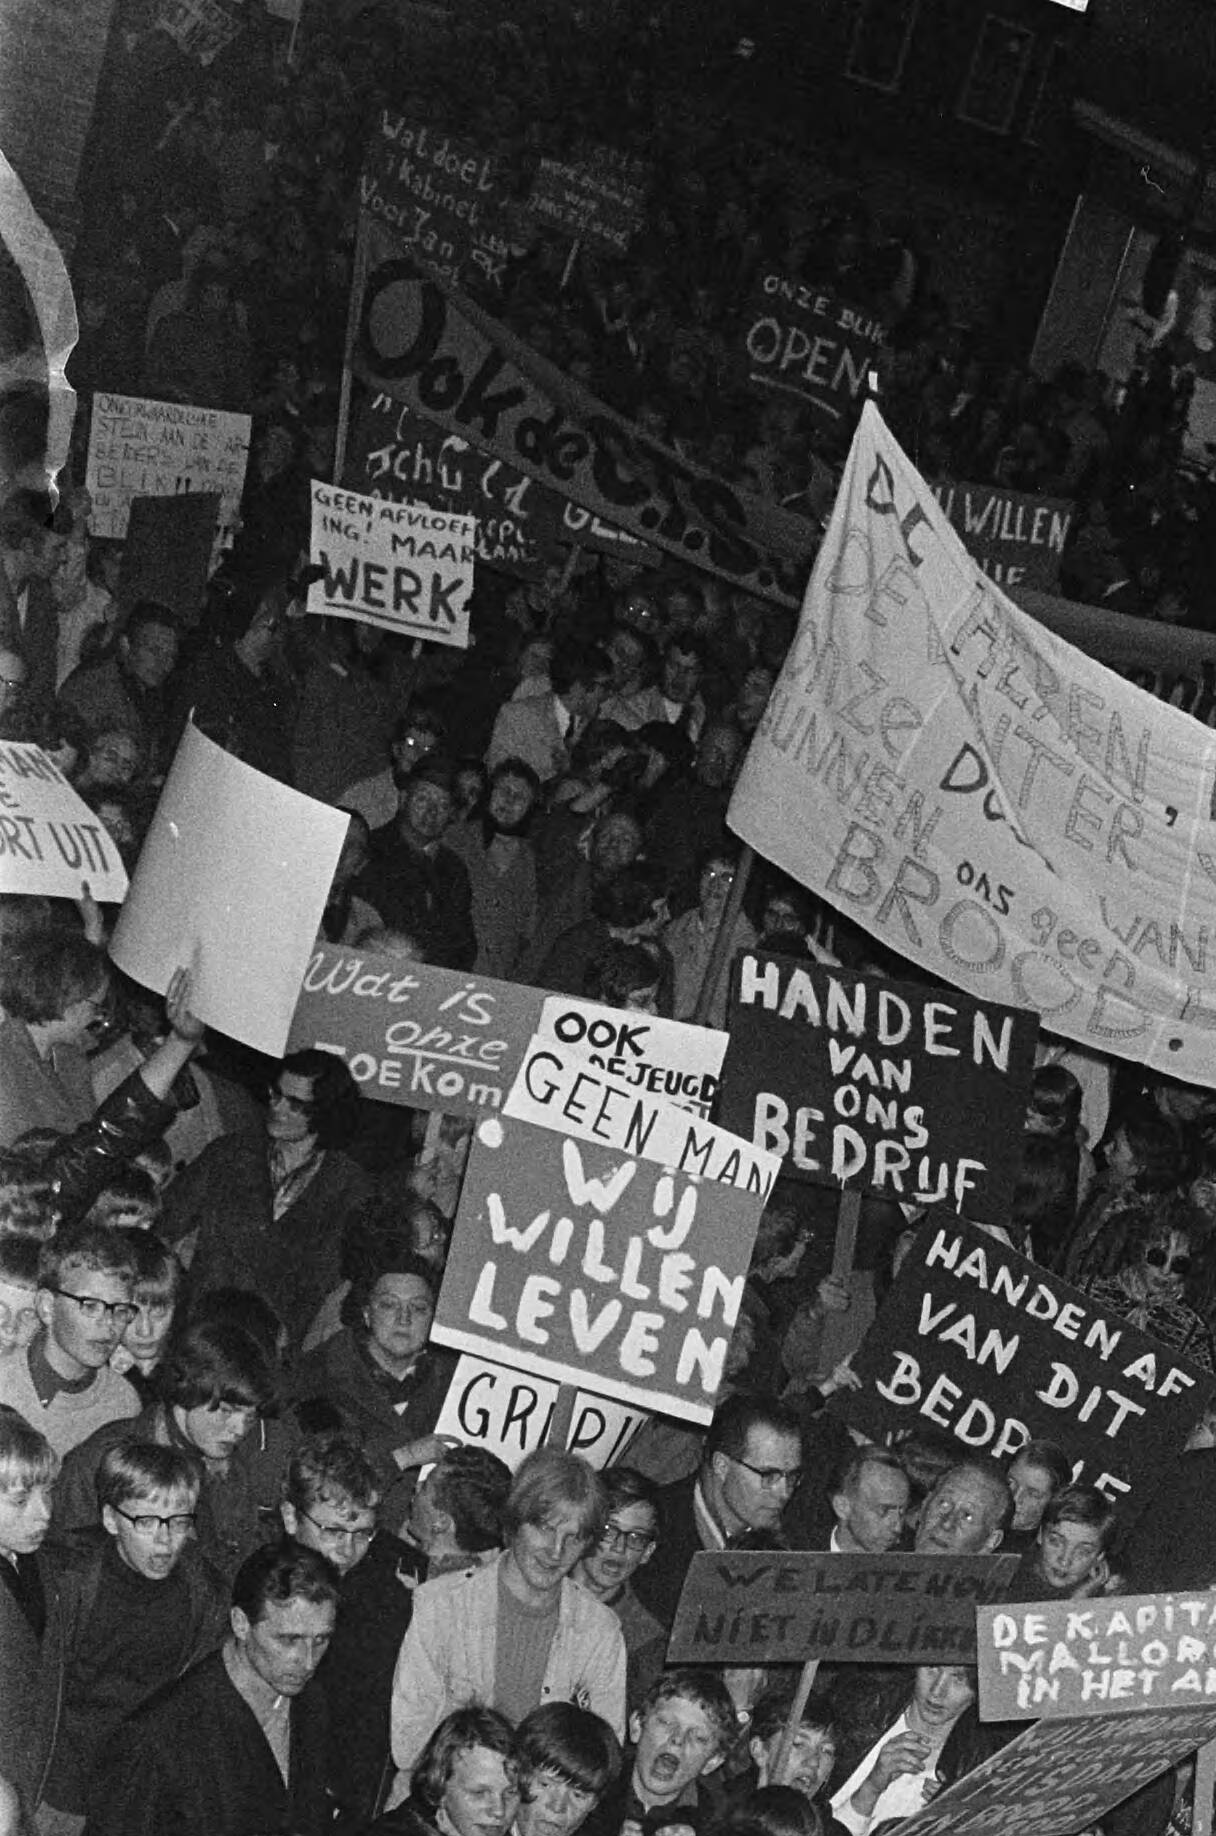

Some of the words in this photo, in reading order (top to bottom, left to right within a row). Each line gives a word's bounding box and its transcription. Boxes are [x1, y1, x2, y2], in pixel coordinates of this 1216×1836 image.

[745, 315, 872, 398] OPEN
[313, 484, 374, 520] GEEN
[964, 491, 1072, 555] WILLEN
[391, 534, 475, 567] MAAR
[319, 547, 464, 622] WERK
[48, 820, 110, 873] UIT
[553, 1010, 651, 1057] OOK
[739, 955, 1014, 1074] HANDEN
[827, 1037, 913, 1094] VAN
[524, 1050, 659, 1157] GEEN
[678, 1125, 775, 1198] MAN
[833, 1084, 929, 1150] ONS
[562, 1137, 699, 1251] WIJ
[486, 1191, 748, 1329] WILLEN
[468, 1260, 730, 1395] LEVEN
[925, 1228, 1125, 1361] HANDEN
[1121, 1352, 1197, 1400] AF
[917, 1291, 1022, 1375] VAN
[1034, 1360, 1146, 1440] DIT
[715, 1564, 799, 1596] WE
[992, 1612, 1049, 1649] DE
[1081, 1668, 1161, 1701] HET
